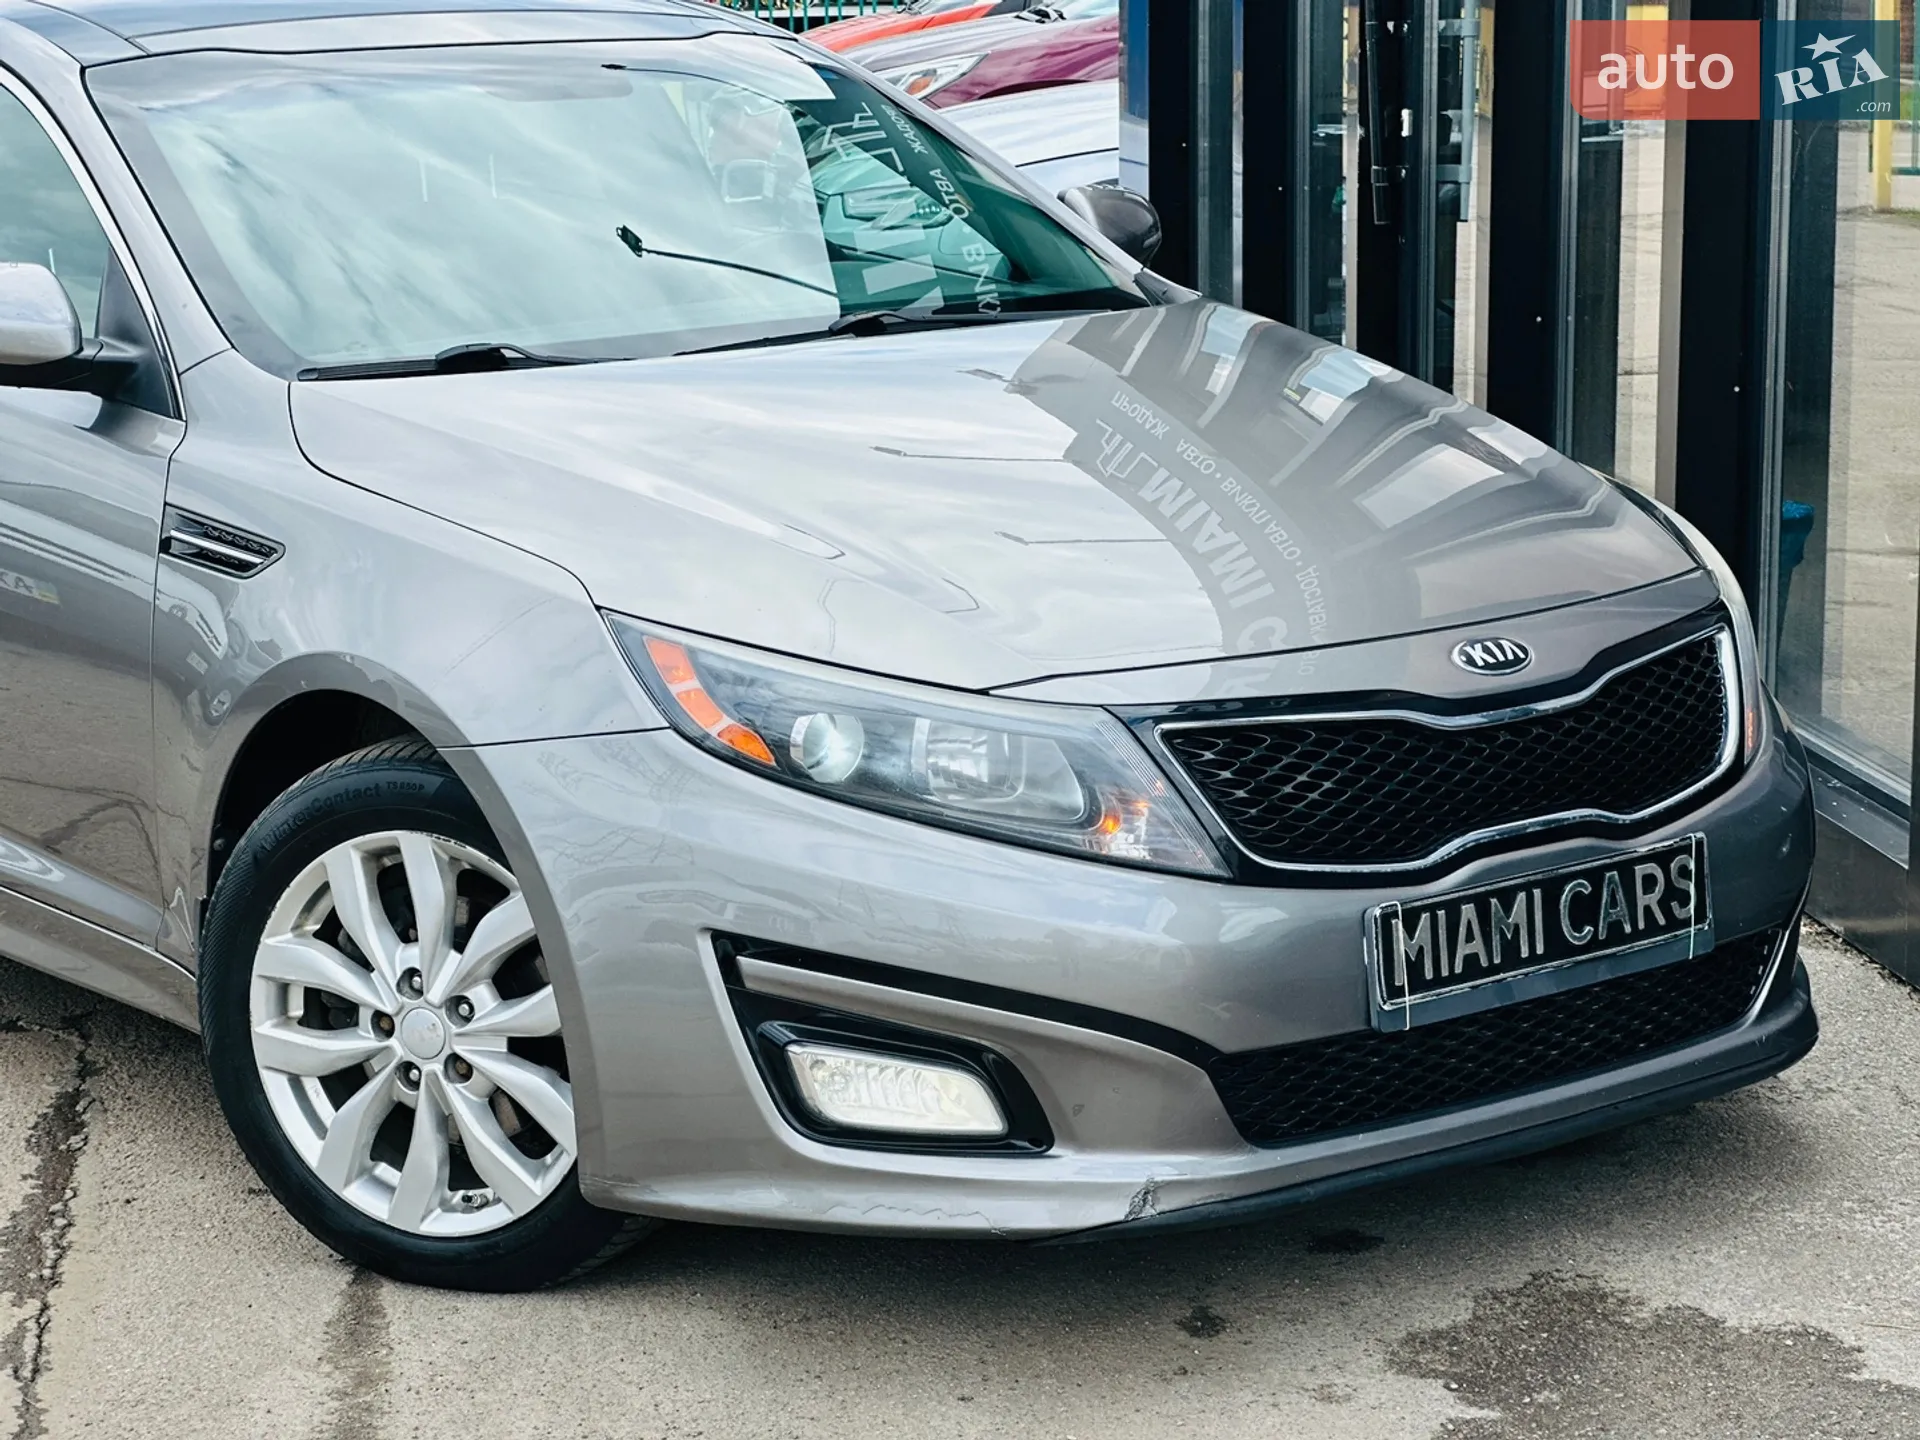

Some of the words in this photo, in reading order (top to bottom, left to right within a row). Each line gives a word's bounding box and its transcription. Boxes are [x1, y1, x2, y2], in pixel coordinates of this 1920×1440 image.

[1462, 639, 1526, 667] KIA
[1391, 888, 1544, 987] MIAMI
[1559, 854, 1697, 945] CARS
